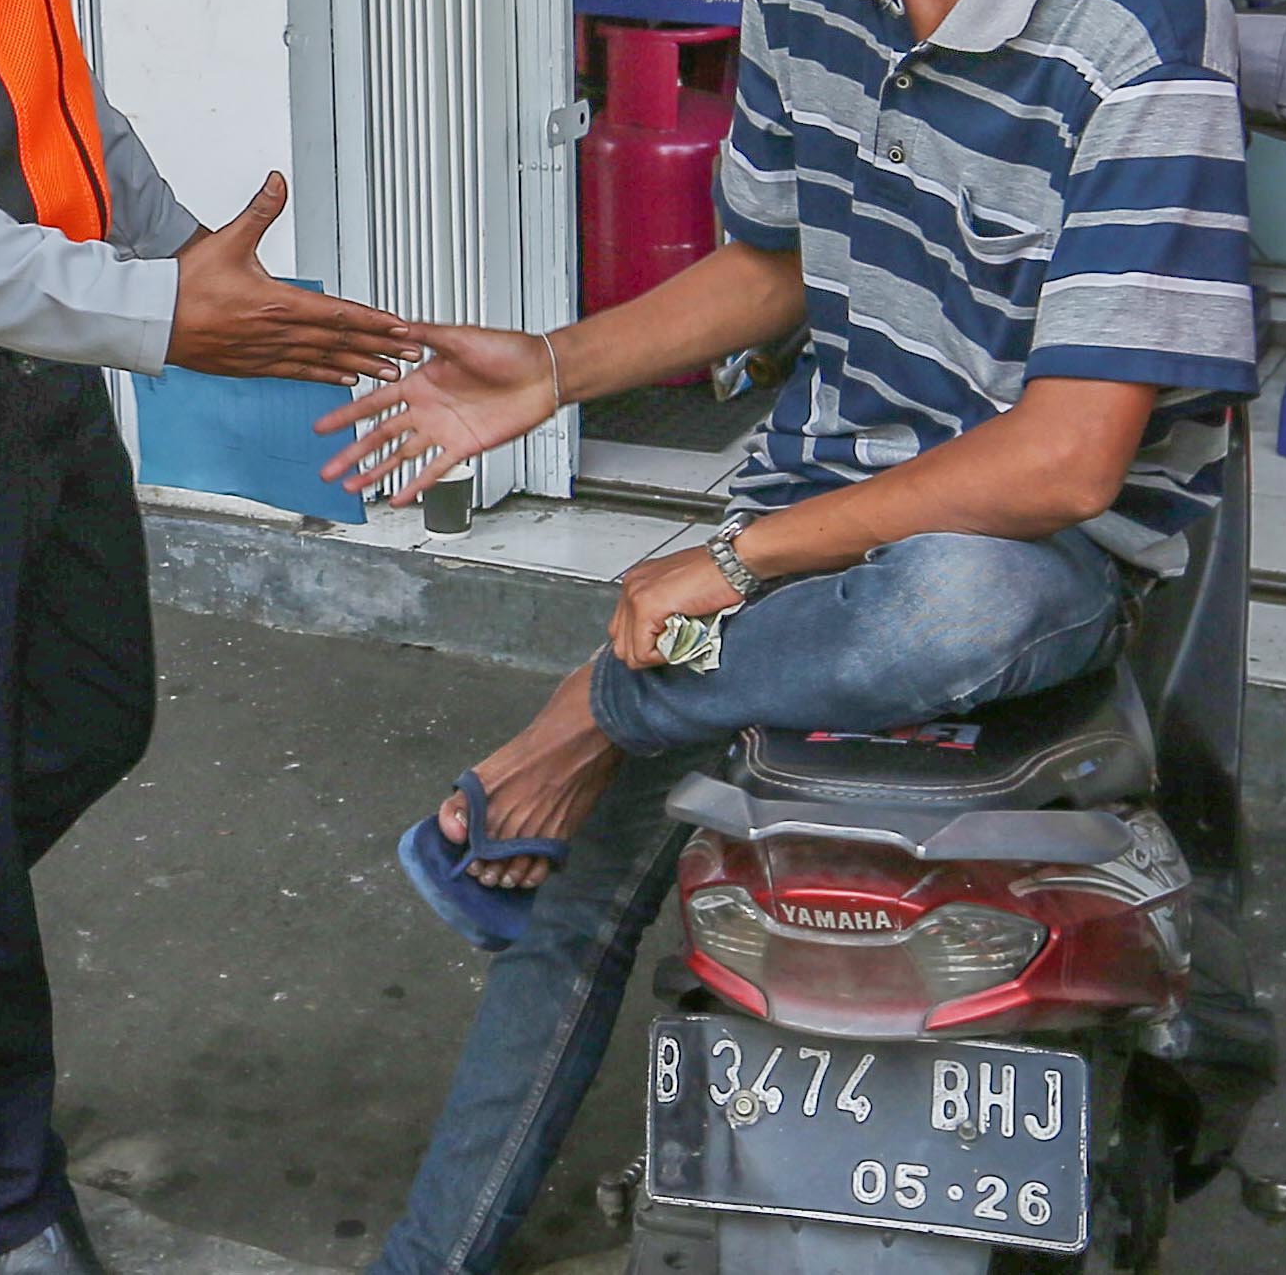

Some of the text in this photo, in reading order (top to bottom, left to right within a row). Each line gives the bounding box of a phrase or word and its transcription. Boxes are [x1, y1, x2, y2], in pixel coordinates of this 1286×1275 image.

[781, 902, 893, 930] YAMAHA
[655, 1036, 1064, 1142] B 3474 BHJ
